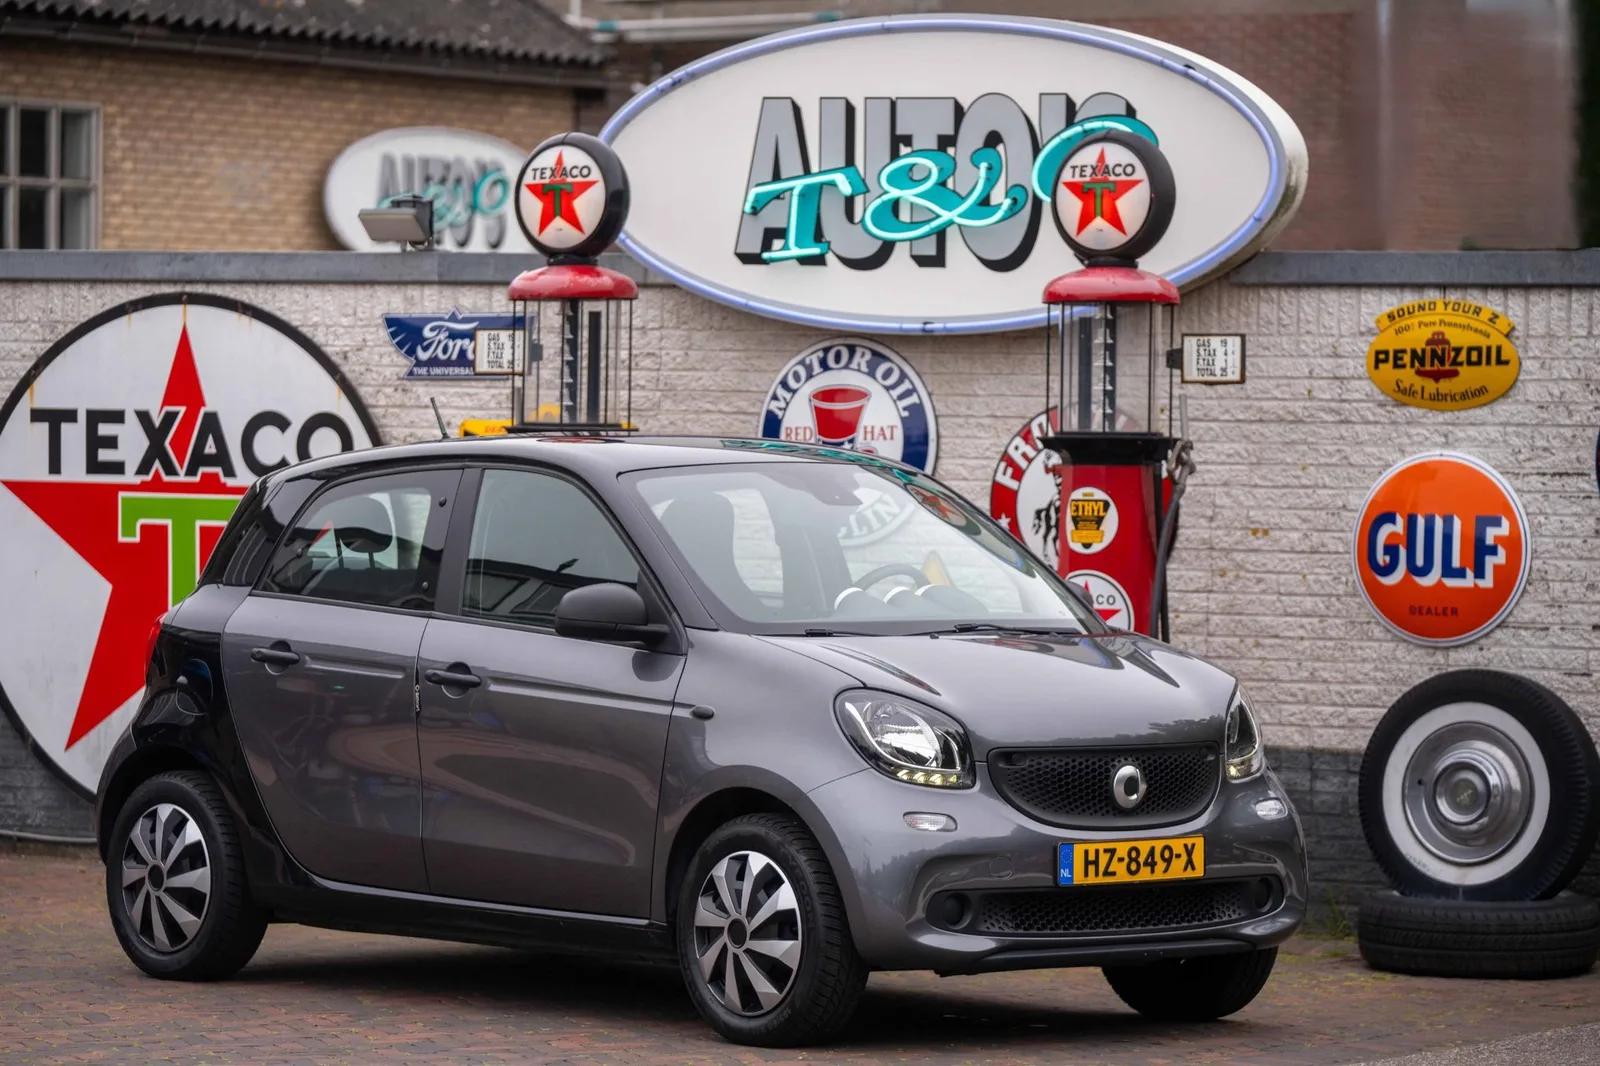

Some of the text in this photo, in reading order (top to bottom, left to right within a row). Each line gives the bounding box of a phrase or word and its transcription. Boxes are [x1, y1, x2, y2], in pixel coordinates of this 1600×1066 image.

[532, 165, 592, 181] TEXACO
[1070, 163, 1136, 179] TEXACO
[735, 92, 1137, 272] AUTO'
[1387, 300, 1500, 325] SOUND YOUR Z
[415, 321, 479, 361] For
[487, 332, 500, 341] GAS
[1196, 338, 1228, 348] GAS 19
[487, 360, 505, 369] TOTAL
[1374, 344, 1511, 370] PENNZOIL
[413, 366, 428, 376] THE
[1196, 367, 1217, 377] TOTAL
[768, 345, 921, 420] MOTOR OIL
[1393, 378, 1489, 403] Safe Lubrication
[784, 424, 898, 442] RED HAT
[30, 408, 354, 478] TEXACO
[1071, 500, 1106, 517] ETHYL
[1367, 511, 1510, 588] GULF
[1409, 604, 1459, 617] DEALER
[1060, 843, 1196, 878] NL HZ-849-X
